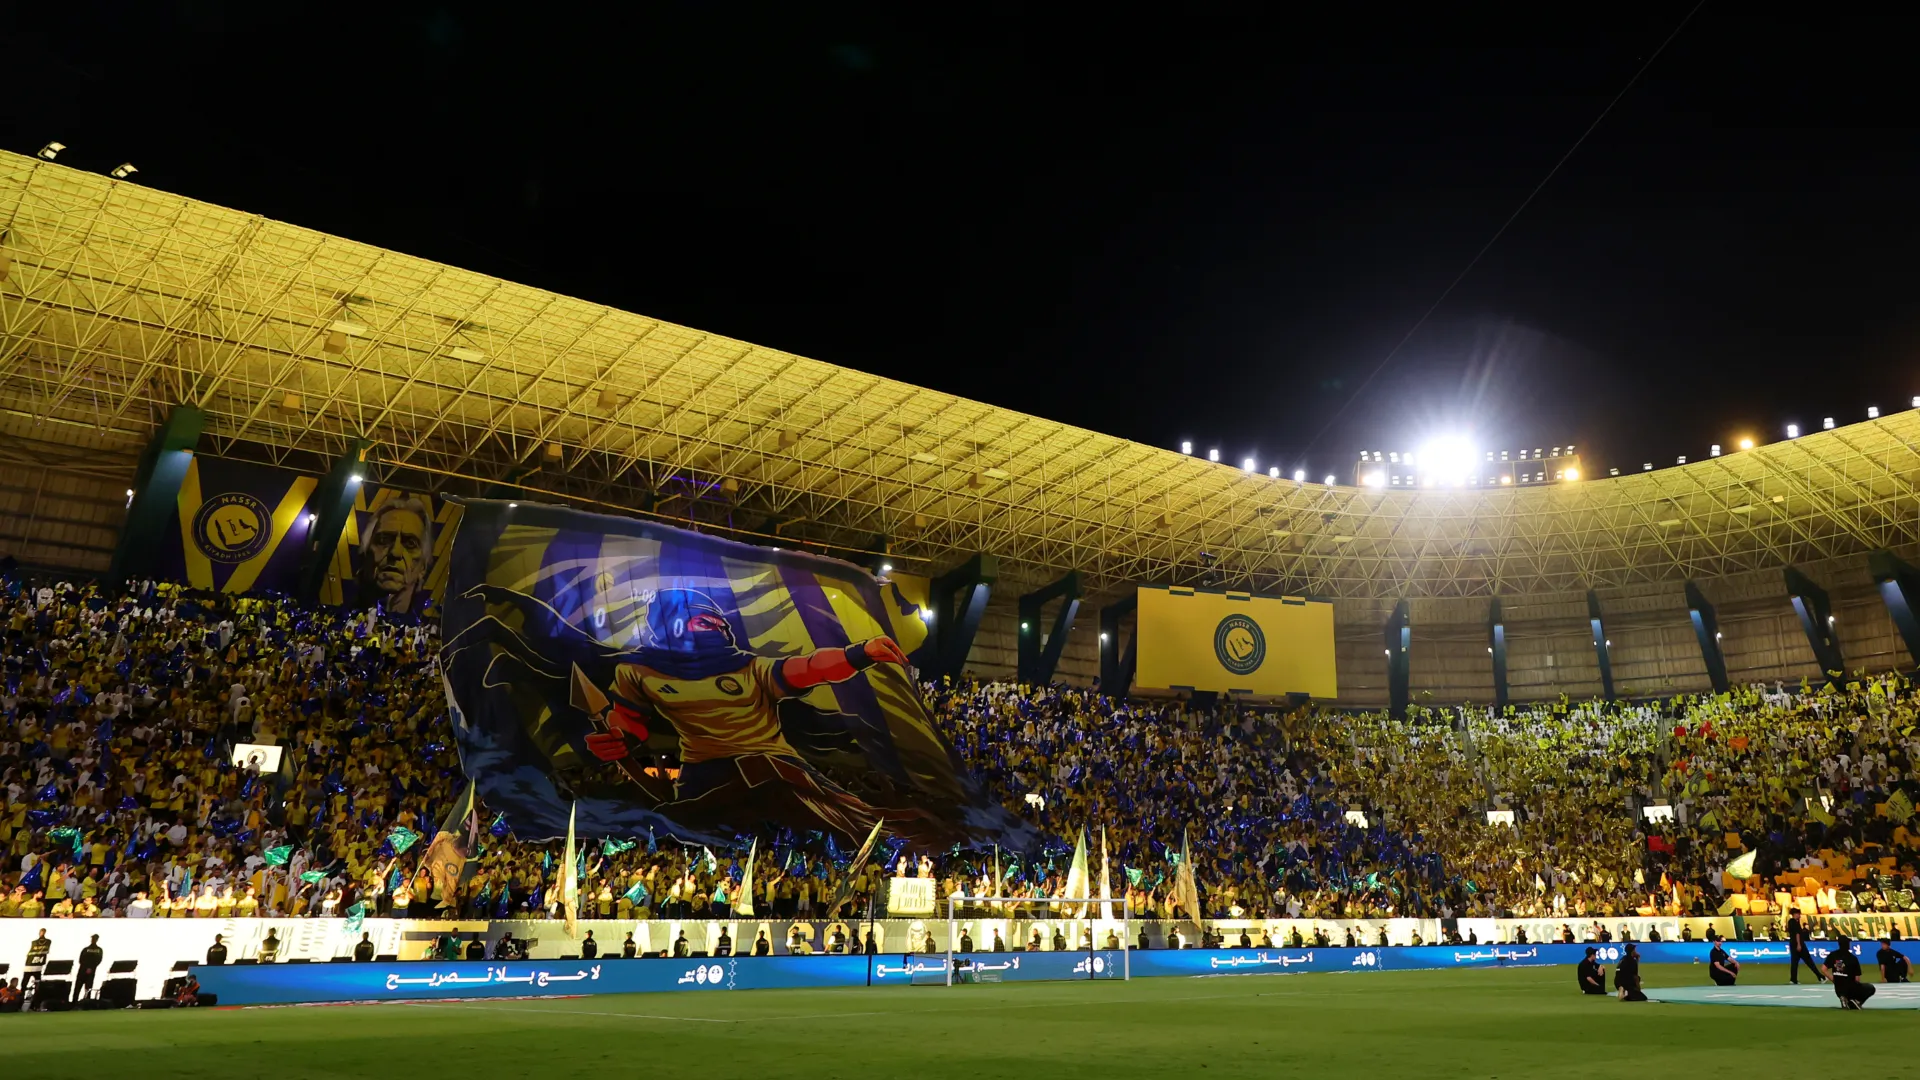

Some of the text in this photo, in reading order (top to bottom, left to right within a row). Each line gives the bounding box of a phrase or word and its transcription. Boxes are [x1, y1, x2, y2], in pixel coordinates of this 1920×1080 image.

[221, 496, 257, 509] NASSR
[204, 544, 231, 559] RIYADH
[1229, 621, 1250, 629] NASSR
[977, 961, 1011, 972] حج
[1012, 957, 1020, 969] لا
[386, 964, 601, 989] لا حج بلا تصريح
